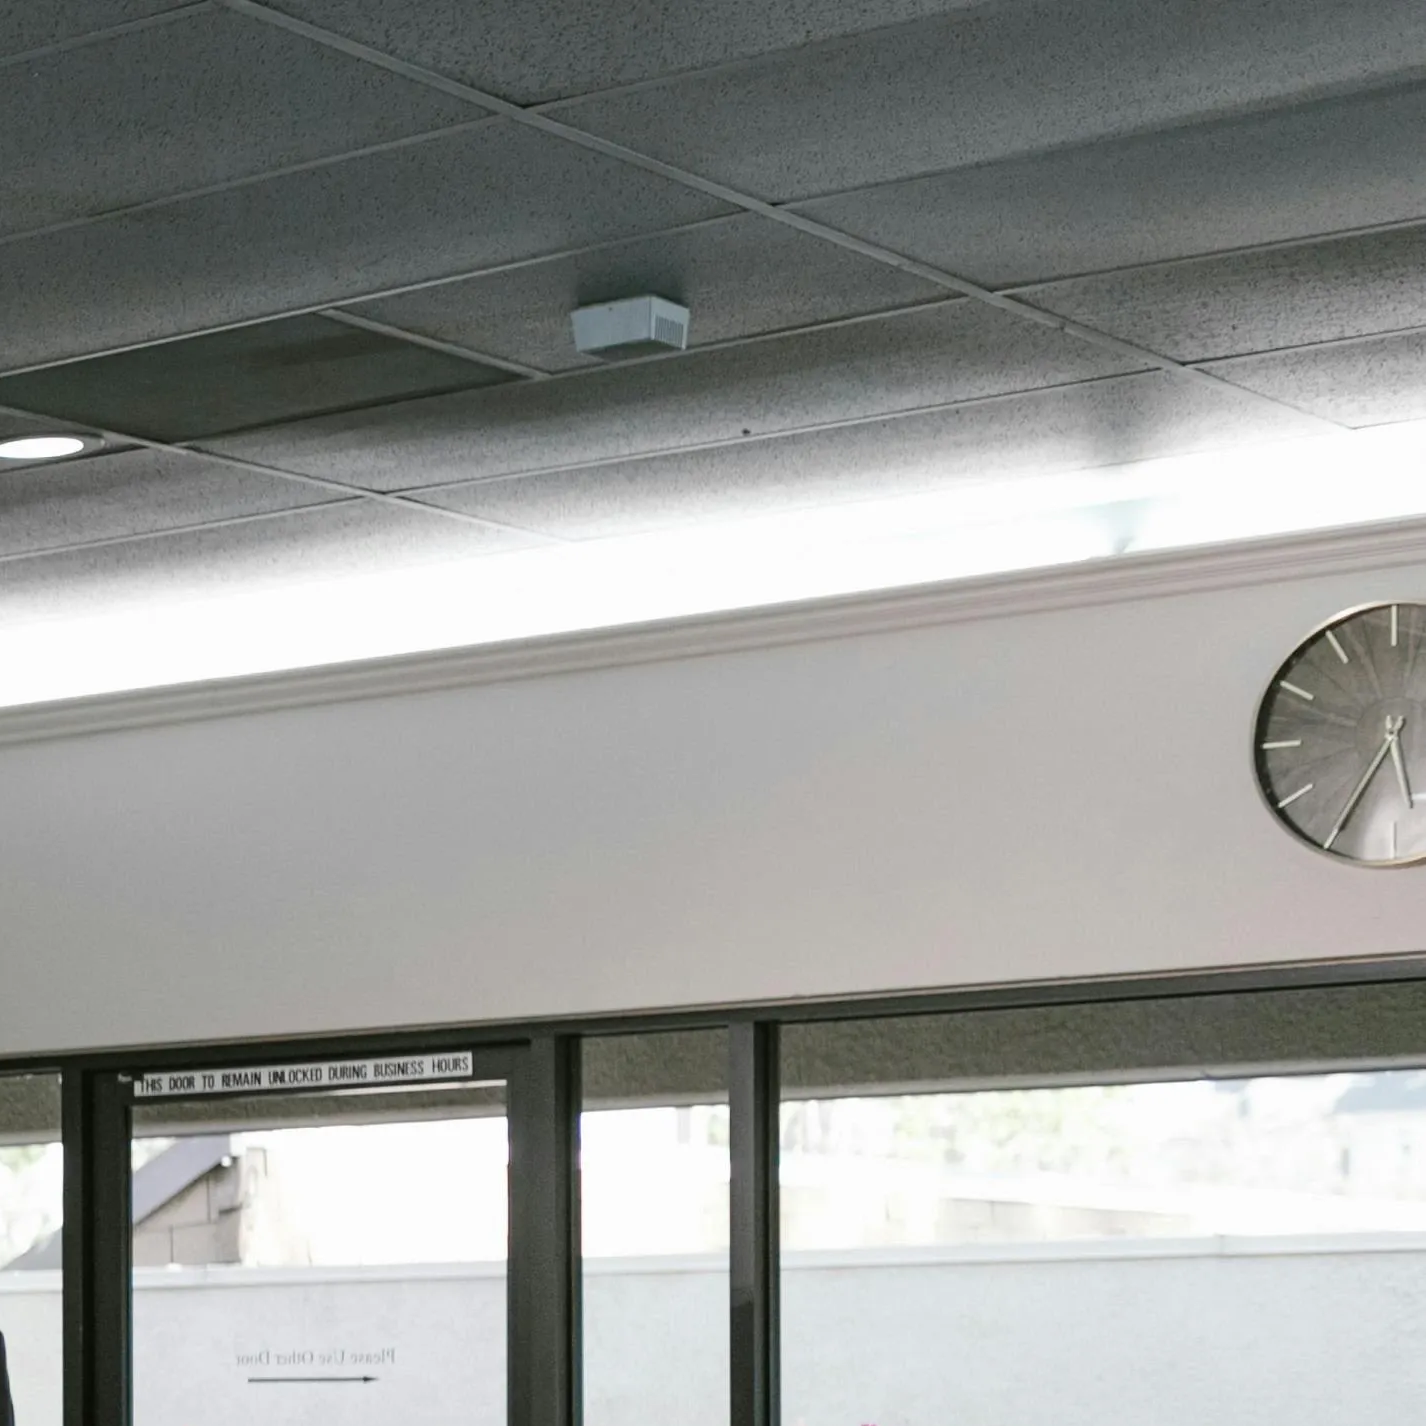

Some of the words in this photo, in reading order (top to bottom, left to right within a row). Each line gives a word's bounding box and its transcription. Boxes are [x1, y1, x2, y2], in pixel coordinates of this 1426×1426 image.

[140, 1076, 162, 1093] THIS
[169, 1073, 195, 1091] DOOR
[201, 1072, 215, 1089] TO
[221, 1069, 261, 1088] REMAIN
[268, 1066, 323, 1086] UNLOCKED
[328, 1063, 367, 1083] DURING
[373, 1060, 424, 1079] BUSINESS
[431, 1056, 469, 1075] HOURS
